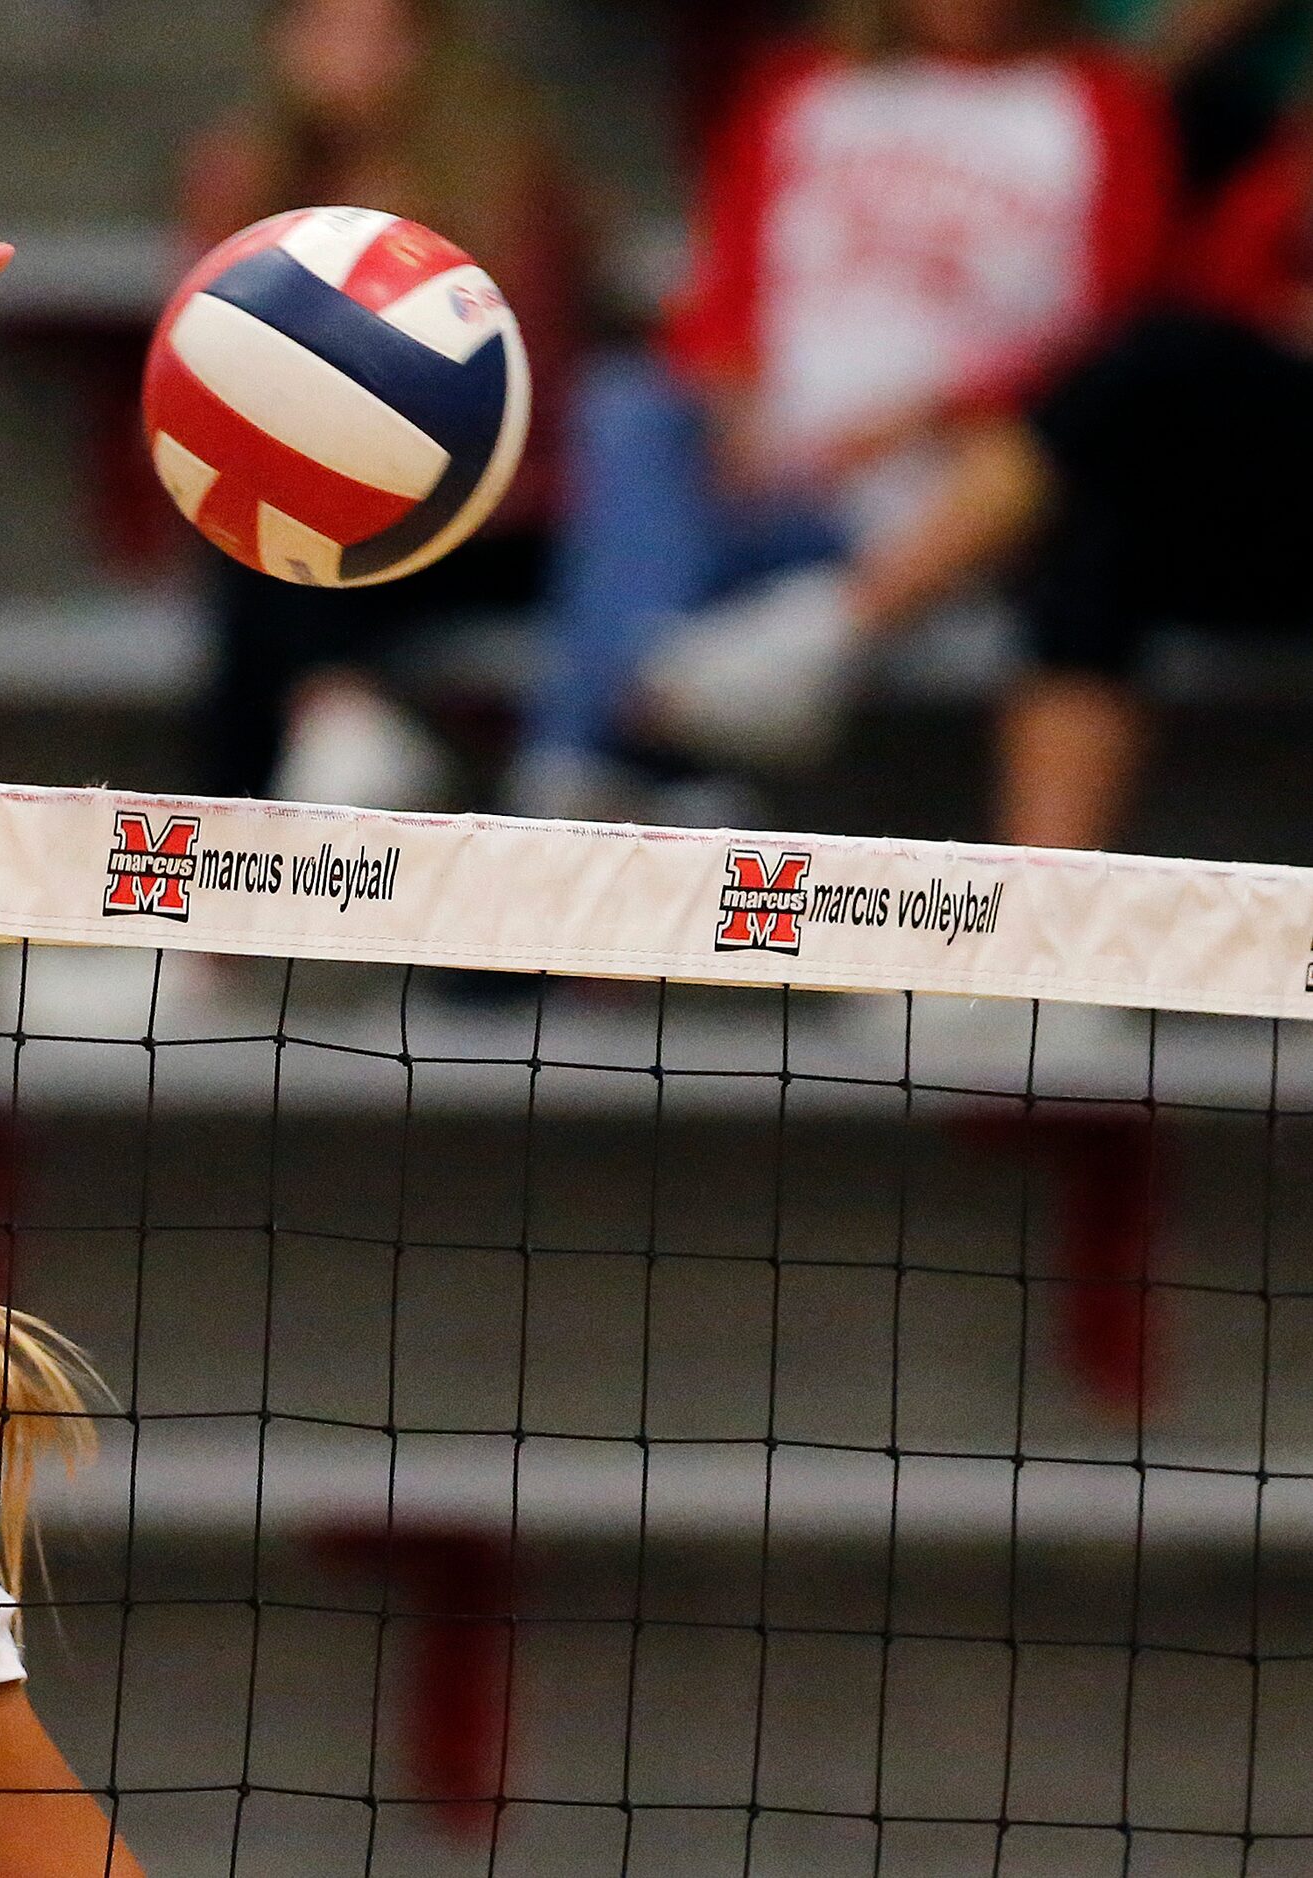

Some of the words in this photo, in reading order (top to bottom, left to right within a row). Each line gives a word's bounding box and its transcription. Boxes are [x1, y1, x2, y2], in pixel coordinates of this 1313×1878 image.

[110, 851, 194, 878] marcus
[198, 847, 284, 894] marcus
[292, 843, 401, 913] volleyball
[722, 888, 807, 913] marcus
[808, 884, 890, 927] marcus
[898, 878, 1004, 946] volleyball
